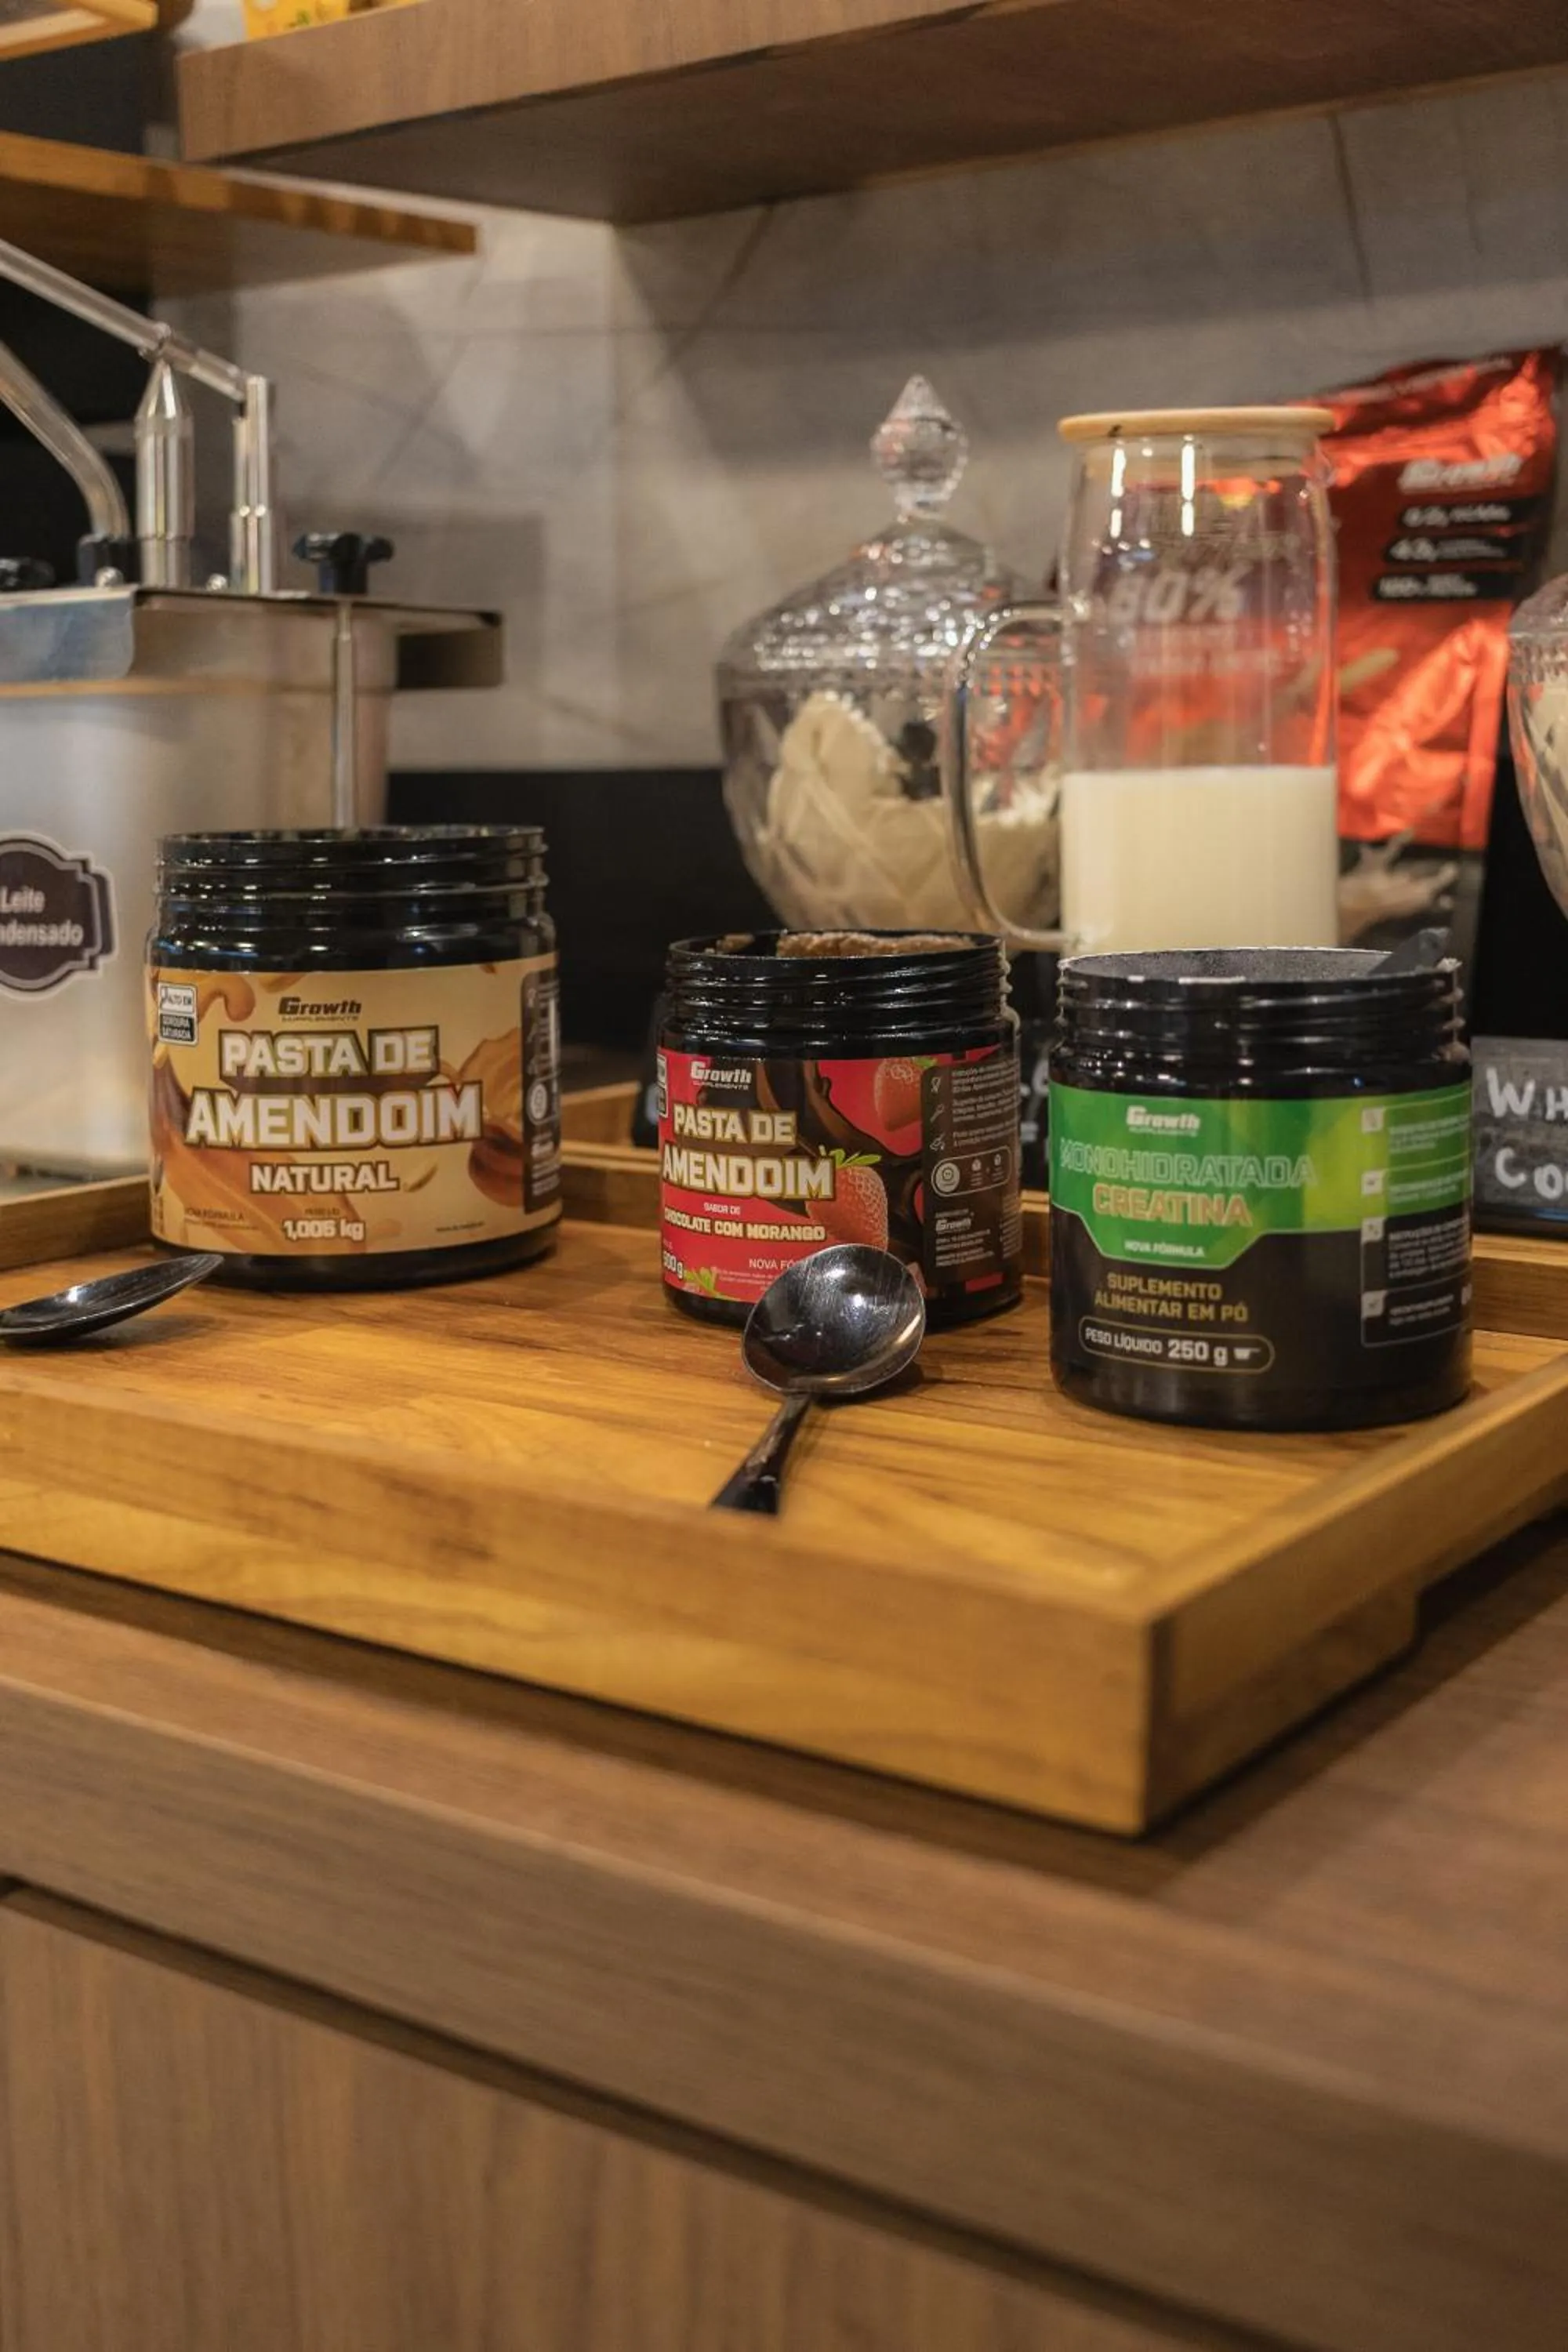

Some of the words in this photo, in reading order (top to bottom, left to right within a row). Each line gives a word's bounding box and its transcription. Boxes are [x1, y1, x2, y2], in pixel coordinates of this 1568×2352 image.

[0, 886, 45, 913] Leite
[278, 996, 362, 1014] Growth
[220, 1031, 365, 1078] PASTA
[372, 1028, 436, 1075] DE
[691, 1062, 753, 1083] Growth
[187, 1083, 482, 1148] AMENDOIM
[673, 1105, 746, 1143] PASTA
[751, 1112, 796, 1145] DE
[1127, 1105, 1201, 1130] Growth
[250, 1163, 398, 1192] NATURAL
[662, 1146, 833, 1199] AMENDOIM
[1060, 1138, 1318, 1188] MONOHIDRATADA
[704, 1202, 728, 1214] SABOR
[1093, 1183, 1253, 1226] CREATINA
[339, 1218, 365, 1241] kg
[714, 1220, 743, 1237] COM
[746, 1223, 826, 1242] MORANGO
[749, 1258, 779, 1270] NOVA
[1107, 1272, 1222, 1301] SUPLEMENTO
[1094, 1290, 1182, 1319] ALIMENTAR
[1188, 1305, 1214, 1322] EM
[1221, 1300, 1248, 1323] PÓ
[1084, 1327, 1112, 1345] PESO
[1114, 1332, 1163, 1354] LÍQUIDO
[1167, 1339, 1209, 1361] 250
[1214, 1347, 1229, 1367] g
